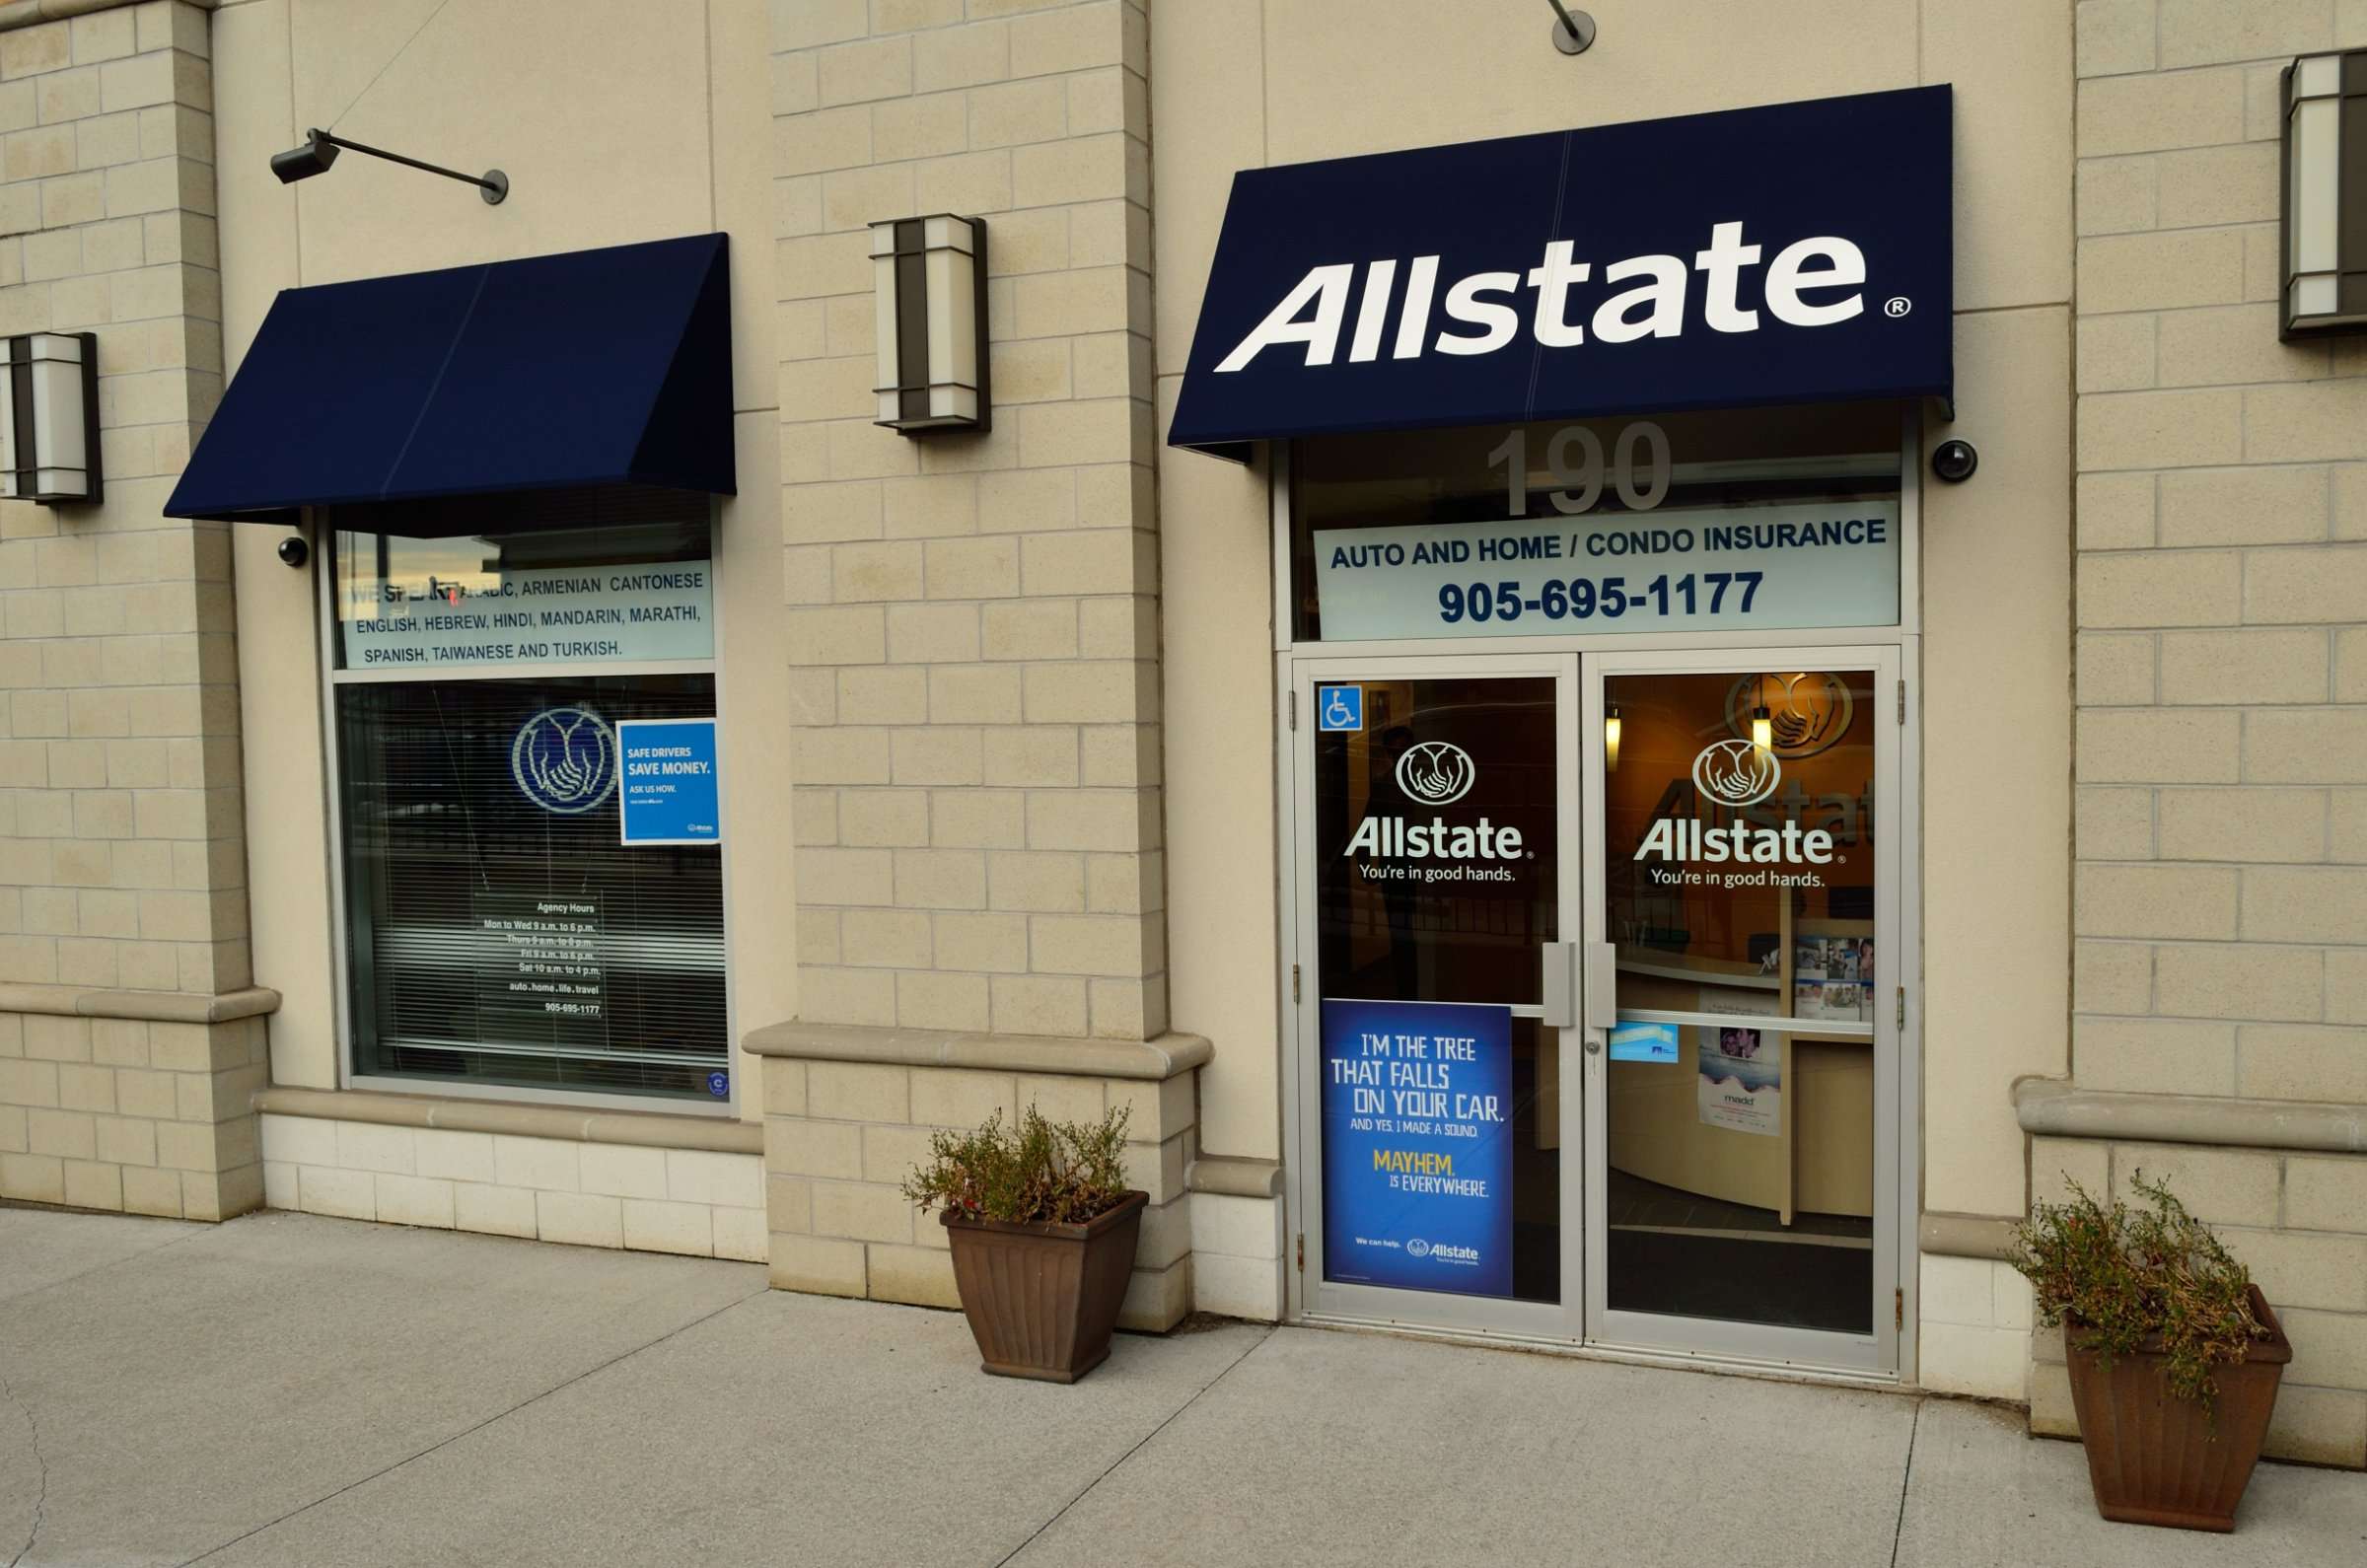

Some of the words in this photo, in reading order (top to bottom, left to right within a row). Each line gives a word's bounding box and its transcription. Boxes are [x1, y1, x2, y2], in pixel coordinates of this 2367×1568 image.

[1213, 221, 1866, 373] Allstate
[1487, 420, 1672, 516] 190
[1330, 543, 1404, 569] AUTO
[1411, 541, 1470, 564] AND
[1479, 535, 1561, 561] HOME
[1569, 533, 1578, 557] /
[1586, 529, 1694, 556] CONDO
[1703, 519, 1887, 550] INSURANCE
[522, 578, 601, 596] ARMENIAN
[610, 573, 702, 591] CANTONESE
[1439, 571, 1763, 623] 905-695-1177
[357, 616, 421, 633] ENGLISH,
[426, 614, 489, 631] HEBREW,
[494, 611, 537, 629] HINDI,
[541, 608, 625, 626] MANDARIN,
[630, 606, 700, 622] MARATHI,
[365, 647, 428, 663] SPANISH,
[432, 644, 513, 661] TAIWANESE
[518, 643, 548, 658] AND
[553, 641, 622, 657] TURKISH.
[627, 748, 650, 758] SAFE
[652, 747, 691, 757] DRIVERS
[628, 762, 660, 775] SAVE
[662, 761, 710, 775] MONEY.
[629, 785, 644, 794] ASK
[656, 784, 677, 793] HOW.
[1343, 817, 1523, 859] Allstate
[1633, 819, 1833, 864] Allstate
[1359, 864, 1404, 879] You're
[1409, 865, 1421, 879] in
[1425, 866, 1462, 883] good
[1466, 866, 1516, 881] hands.
[1651, 869, 1701, 885] You're
[1706, 870, 1720, 885] in
[1724, 870, 1765, 889] good
[1769, 871, 1825, 887] hands.
[538, 902, 568, 914] Agency
[569, 903, 595, 913] Hours
[484, 919, 502, 929] Mon
[503, 920, 512, 929] to
[514, 920, 533, 930] Wed
[540, 922, 558, 931] a.m.
[559, 923, 568, 932] to
[577, 924, 596, 934] p.m.
[559, 951, 568, 960] to
[519, 962, 533, 972] Sat
[535, 963, 545, 972] 10
[546, 964, 564, 973] a.m.
[565, 965, 574, 974] to
[583, 967, 601, 977] p.m.
[545, 1002, 601, 1014] 905-695-1177
[1361, 1033, 1389, 1057] I'M
[1395, 1034, 1427, 1059] THE
[1434, 1036, 1475, 1061] TREE
[1331, 1058, 1383, 1085] THAT
[1390, 1061, 1449, 1090] FALLS
[1354, 1088, 1385, 1114] ON
[1393, 1090, 1449, 1118] YOUR
[1456, 1094, 1504, 1122] CAR.
[1350, 1118, 1372, 1131] AND
[1397, 1120, 1400, 1133] I
[1403, 1121, 1431, 1134] MADE
[1434, 1123, 1442, 1135] A
[1390, 1175, 1399, 1187] IS
[1401, 1176, 1490, 1198] EVERYWHERE.
[1383, 1239, 1400, 1248] help.
[1430, 1244, 1478, 1260] Allstate
